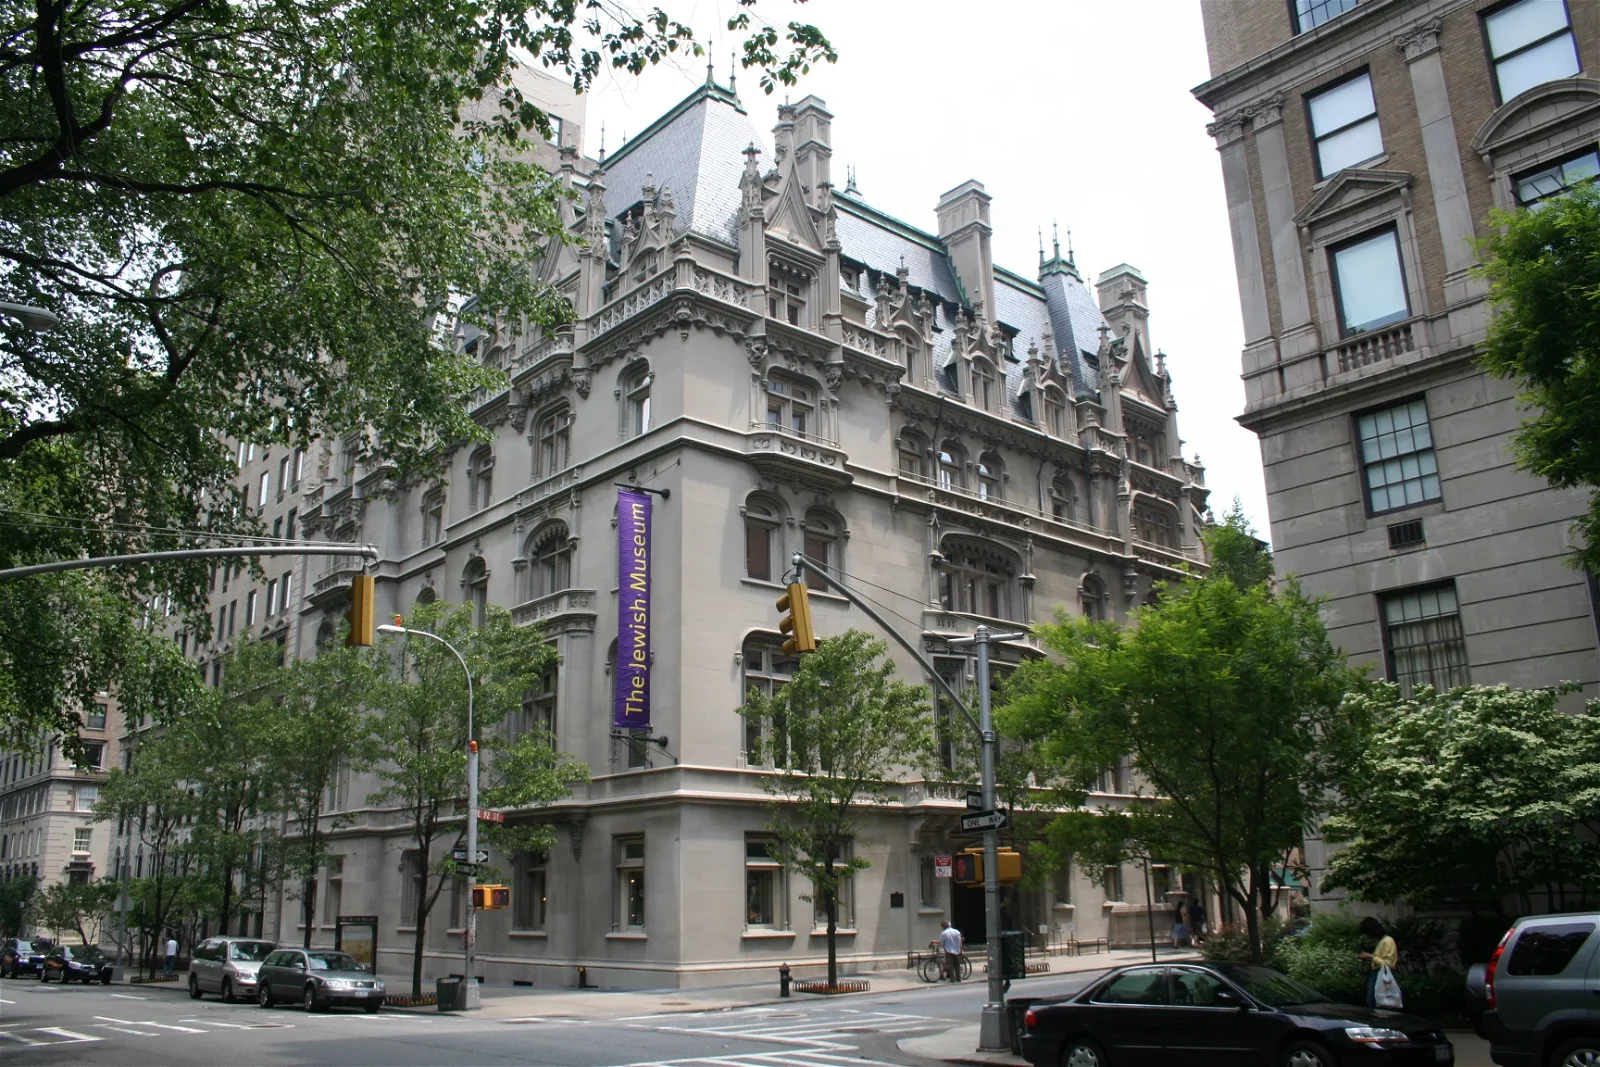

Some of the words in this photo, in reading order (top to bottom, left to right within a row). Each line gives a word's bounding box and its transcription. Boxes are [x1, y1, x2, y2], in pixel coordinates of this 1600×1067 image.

[630, 503, 647, 592] Museum
[628, 599, 647, 670] Jewish
[625, 676, 645, 716] The
[483, 811, 490, 819] 92
[493, 813, 500, 821] ST
[967, 818, 981, 828] ONE
[988, 814, 1002, 824] WAY
